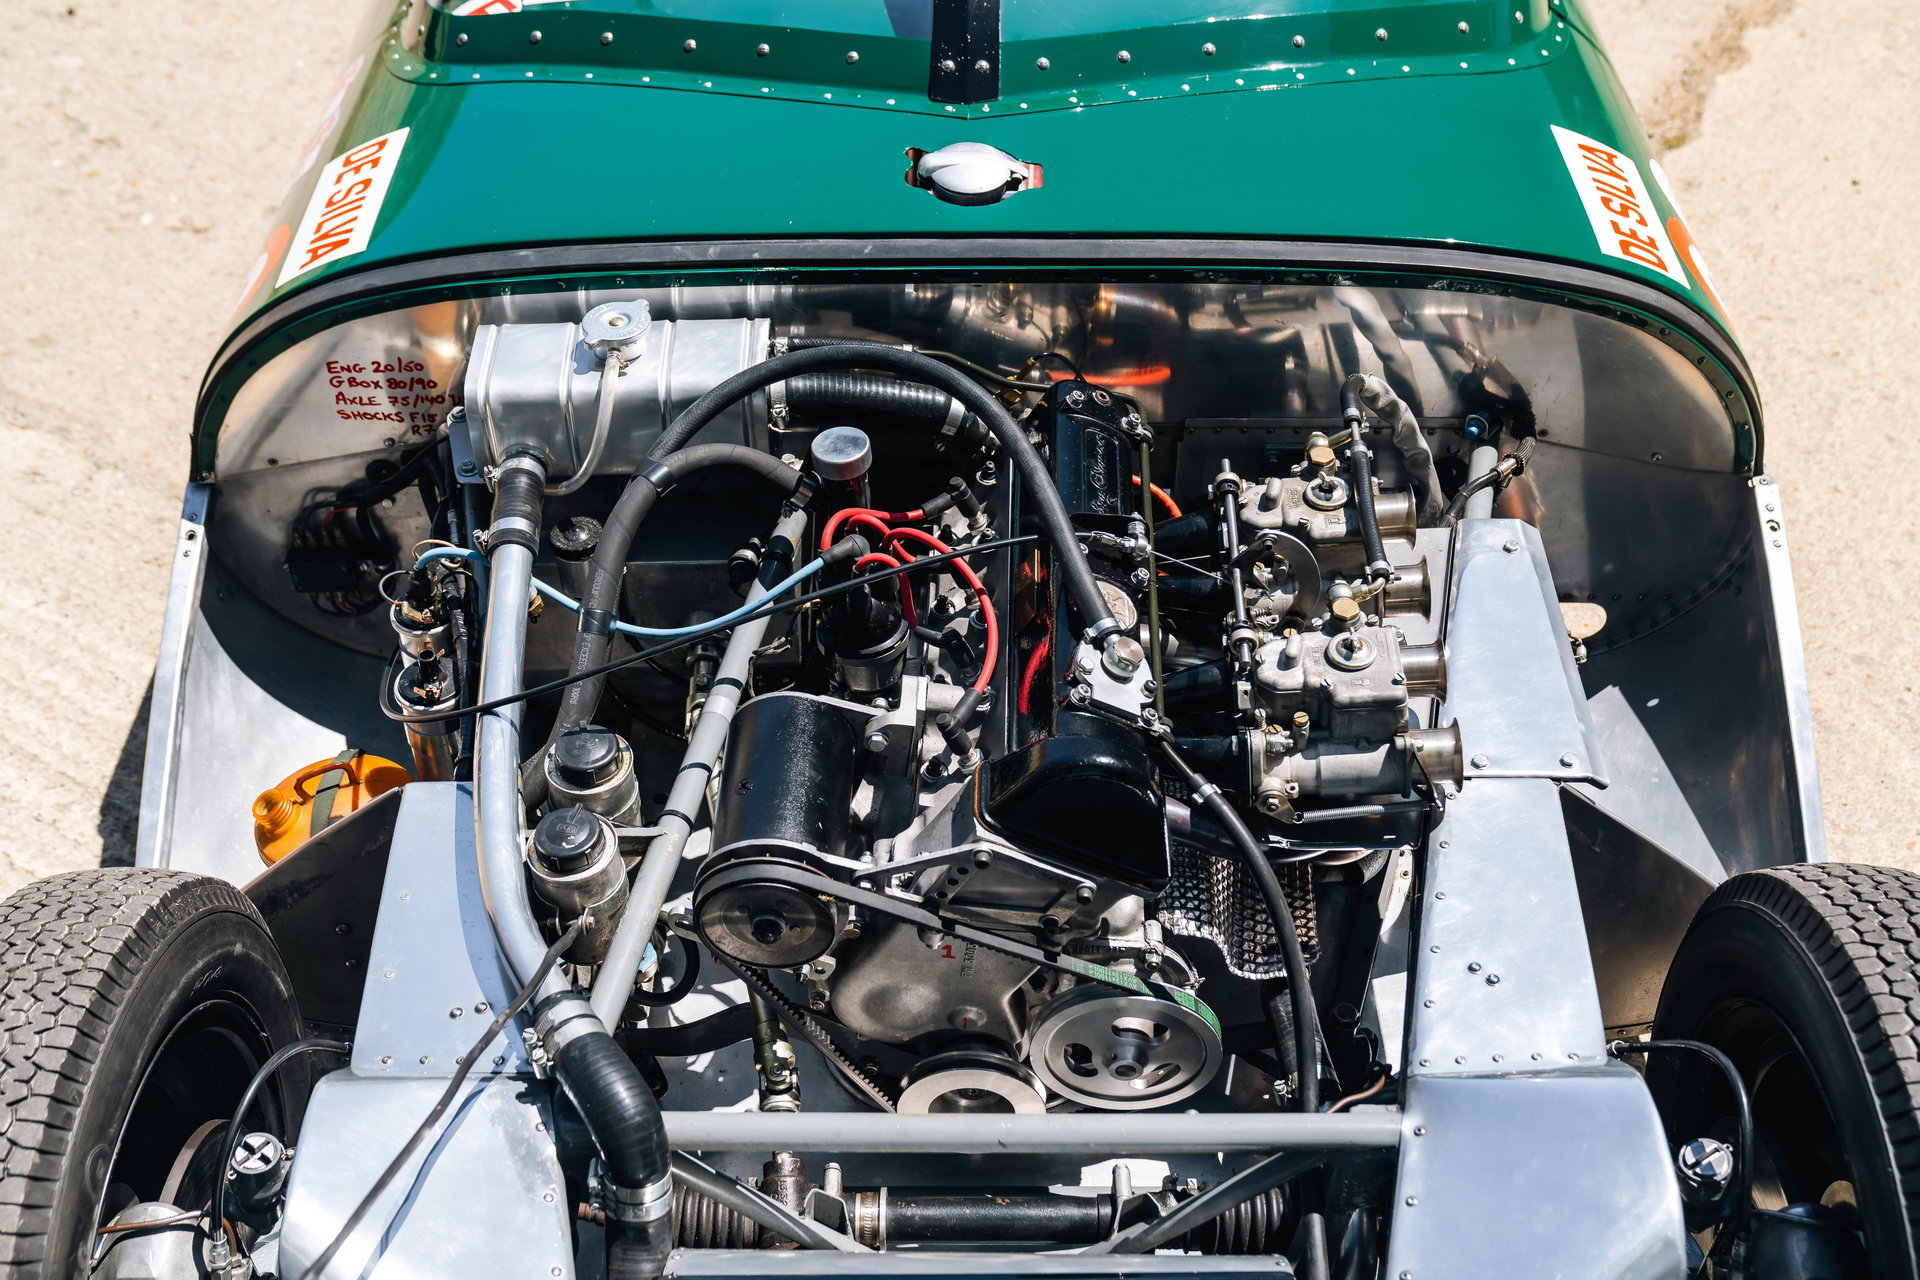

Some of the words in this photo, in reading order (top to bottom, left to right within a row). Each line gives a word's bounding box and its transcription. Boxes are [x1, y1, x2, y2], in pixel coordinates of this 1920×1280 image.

[336, 138, 388, 185] DE
[1578, 144, 1648, 227] SILVA
[301, 178, 373, 269] SILVA
[1611, 220, 1669, 273] DE
